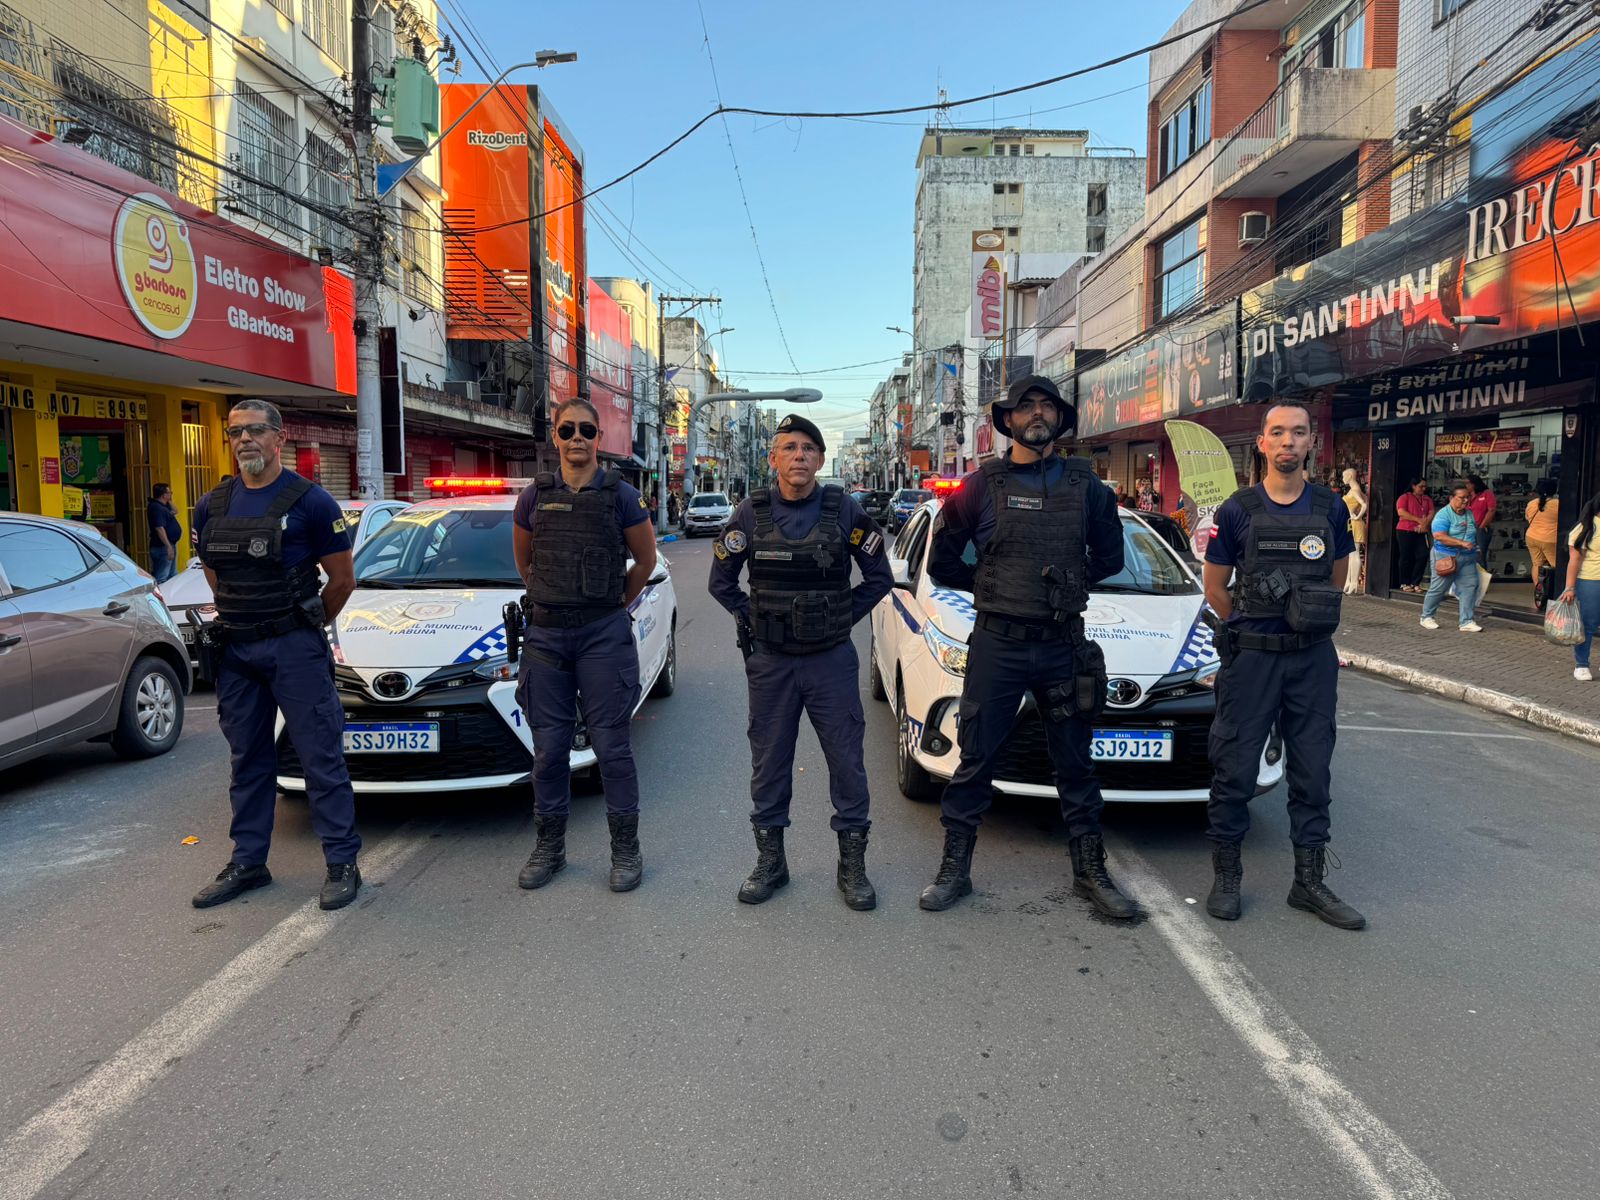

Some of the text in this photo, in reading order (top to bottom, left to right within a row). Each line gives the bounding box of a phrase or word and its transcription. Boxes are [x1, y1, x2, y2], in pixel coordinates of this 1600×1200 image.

[468, 130, 526, 145] RizoDent
[134, 274, 187, 301] gbarbosa
[204, 255, 306, 313] Eletro Show
[142, 296, 181, 316] cencosud
[1253, 262, 1441, 358] DI SANTINNI
[227, 305, 295, 343] GBarbosa
[1107, 353, 1146, 398] OUTLET
[1368, 380, 1527, 421] DI SANTINNI
[1377, 438, 1390, 450] 358
[1193, 480, 1214, 489] Faça
[1194, 487, 1221, 499] já seu
[1196, 495, 1224, 505] cartão
[425, 623, 484, 631] MUNICIPAL
[1112, 628, 1174, 639] MUNICIPAL
[352, 732, 430, 749] SSJ9H32
[1089, 740, 1163, 757] SJ9J12
